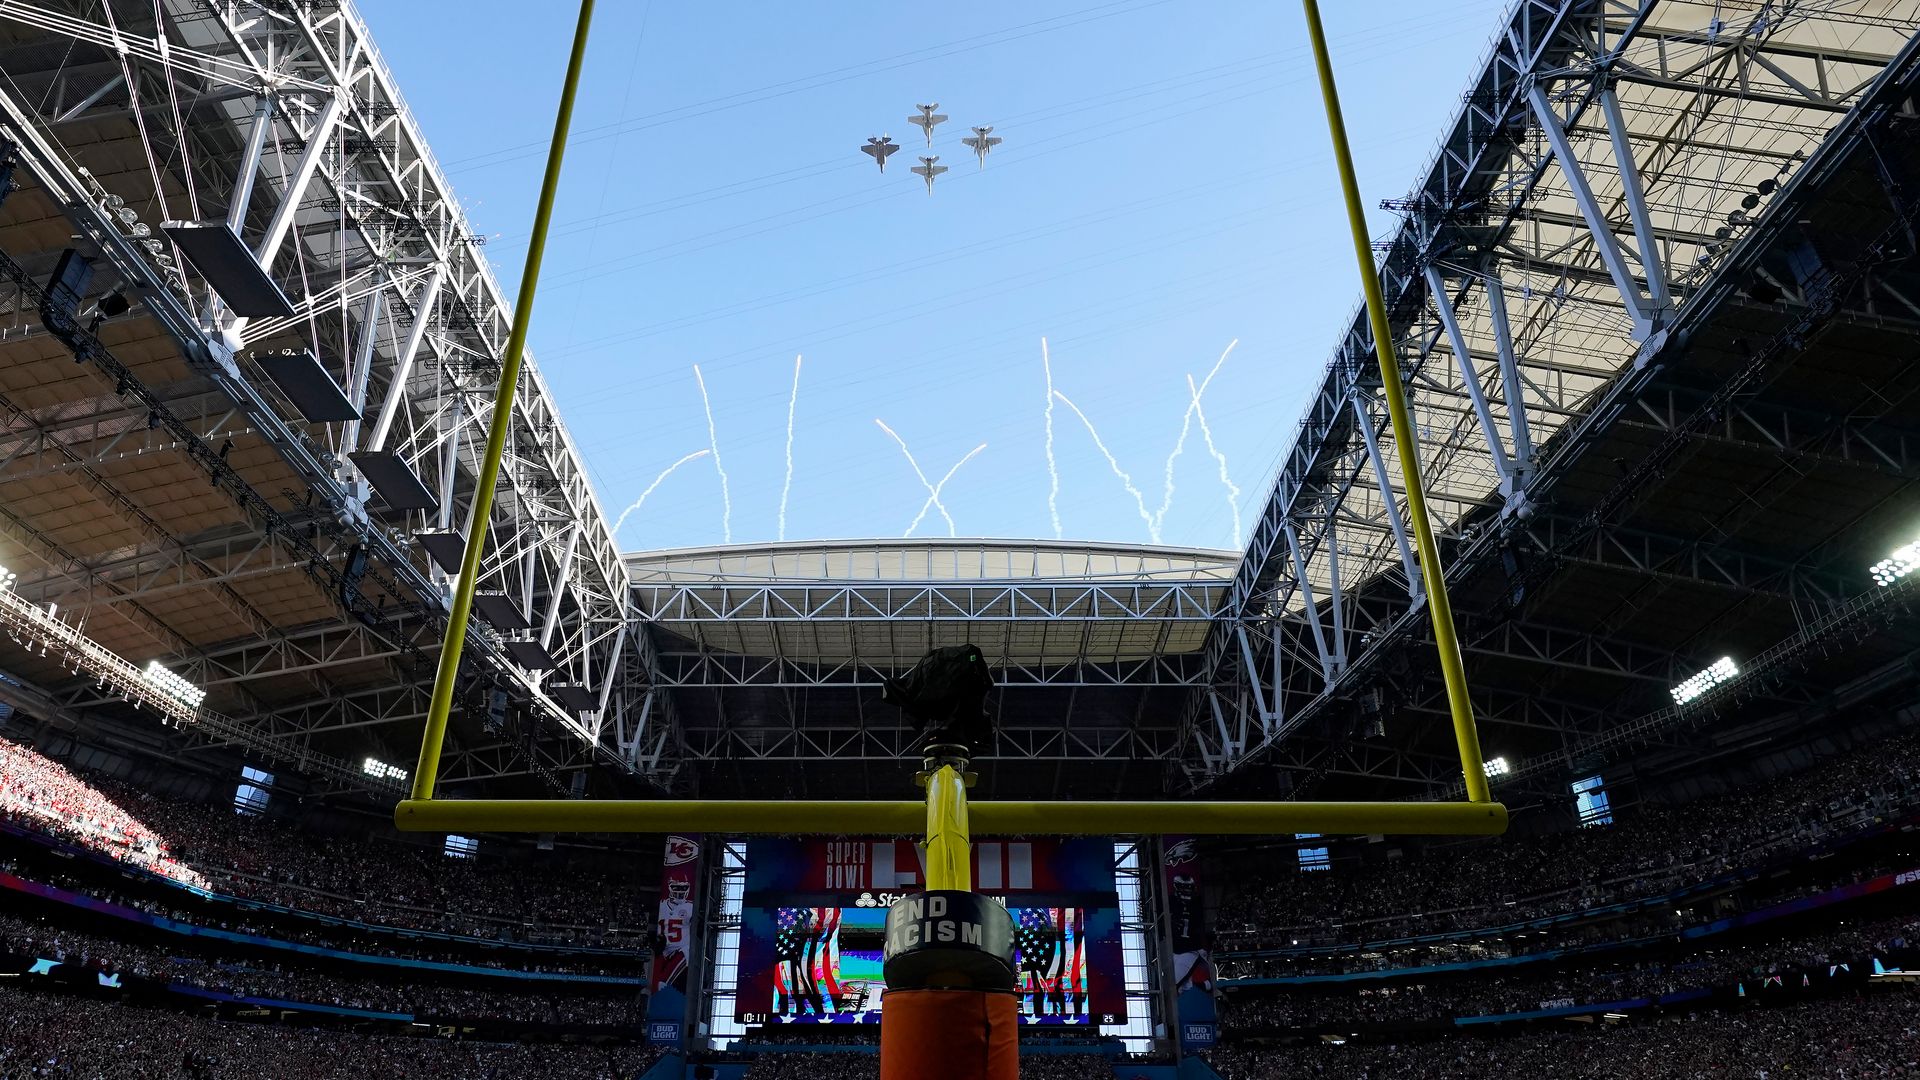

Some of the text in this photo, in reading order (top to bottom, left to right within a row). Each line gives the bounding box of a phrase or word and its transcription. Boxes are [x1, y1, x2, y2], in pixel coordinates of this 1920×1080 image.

[827, 842, 866, 864] SUPER
[872, 842, 1033, 889] LII
[826, 865, 865, 889] BOWL
[894, 896, 947, 928] END
[658, 919, 683, 942] 15
[743, 1013, 766, 1023] 10:11
[1103, 1014, 1114, 1023] 25
[652, 1031, 677, 1039] LIGHT
